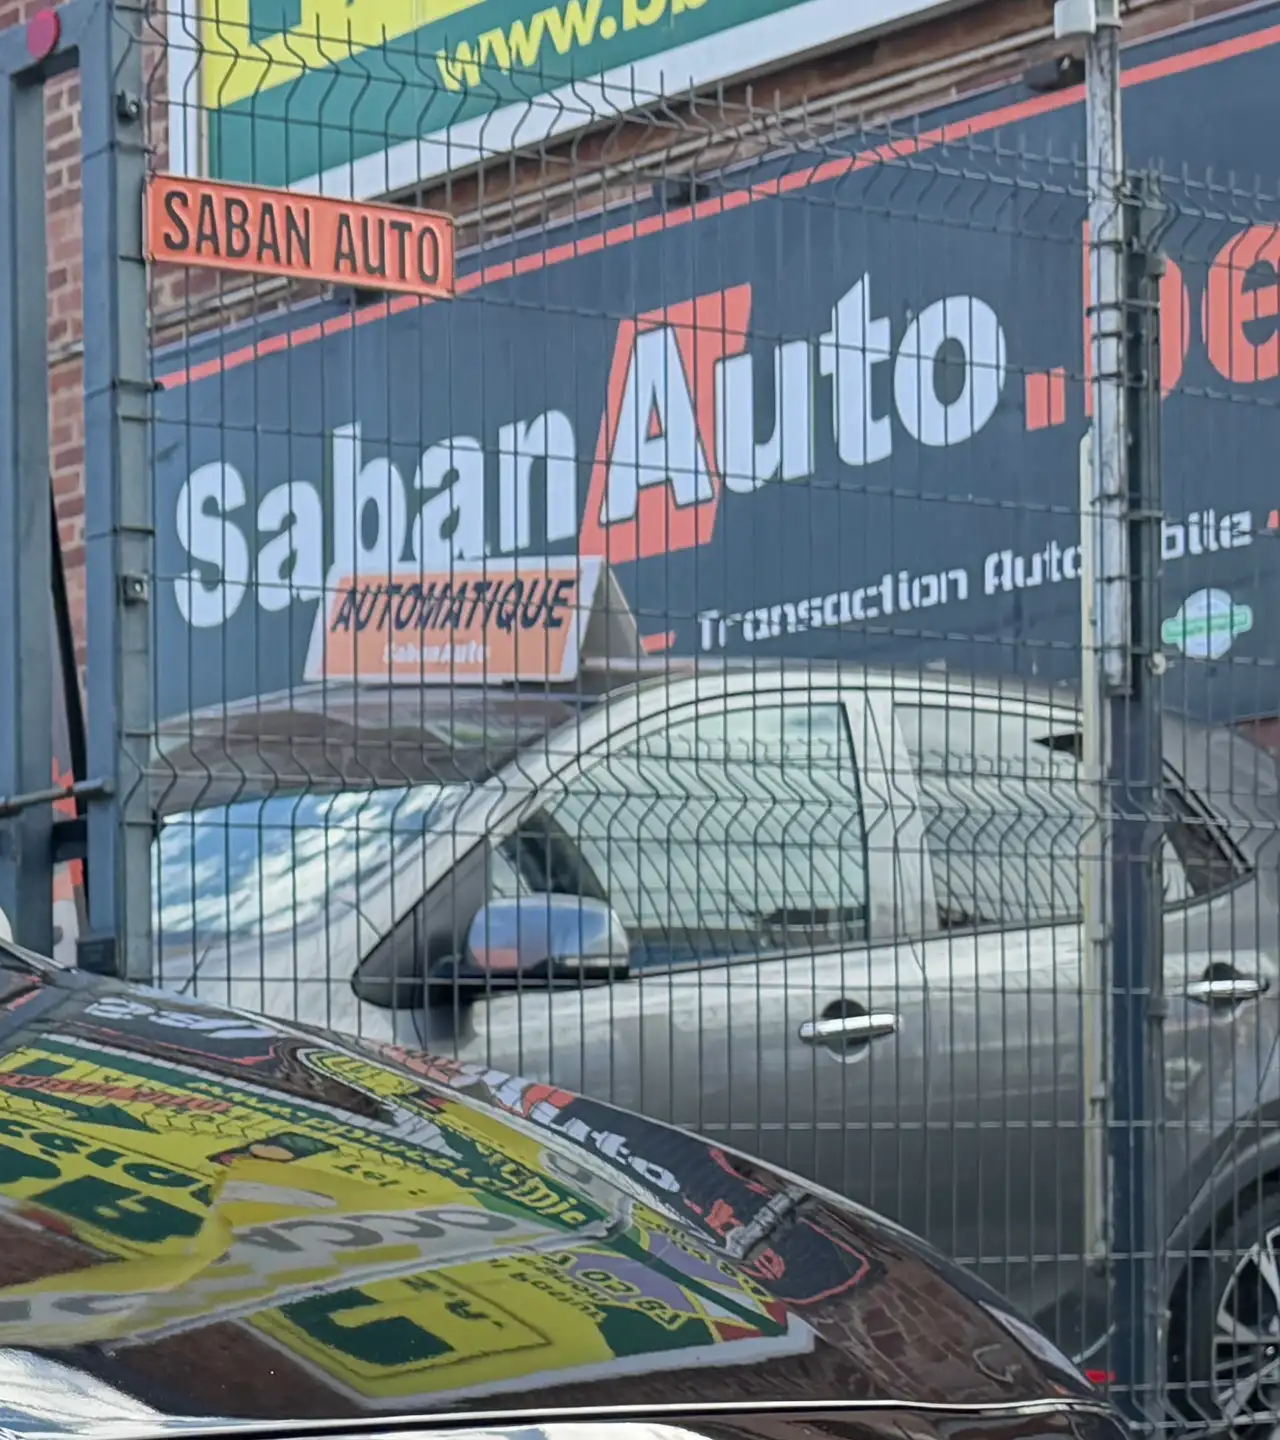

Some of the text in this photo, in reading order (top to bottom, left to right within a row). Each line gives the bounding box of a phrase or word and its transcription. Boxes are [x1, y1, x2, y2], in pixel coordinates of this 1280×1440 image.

[163, 190, 441, 284] SABAN AUTO
[330, 577, 577, 633] AUTOMATIQUE
[697, 569, 968, 651] Transaction
